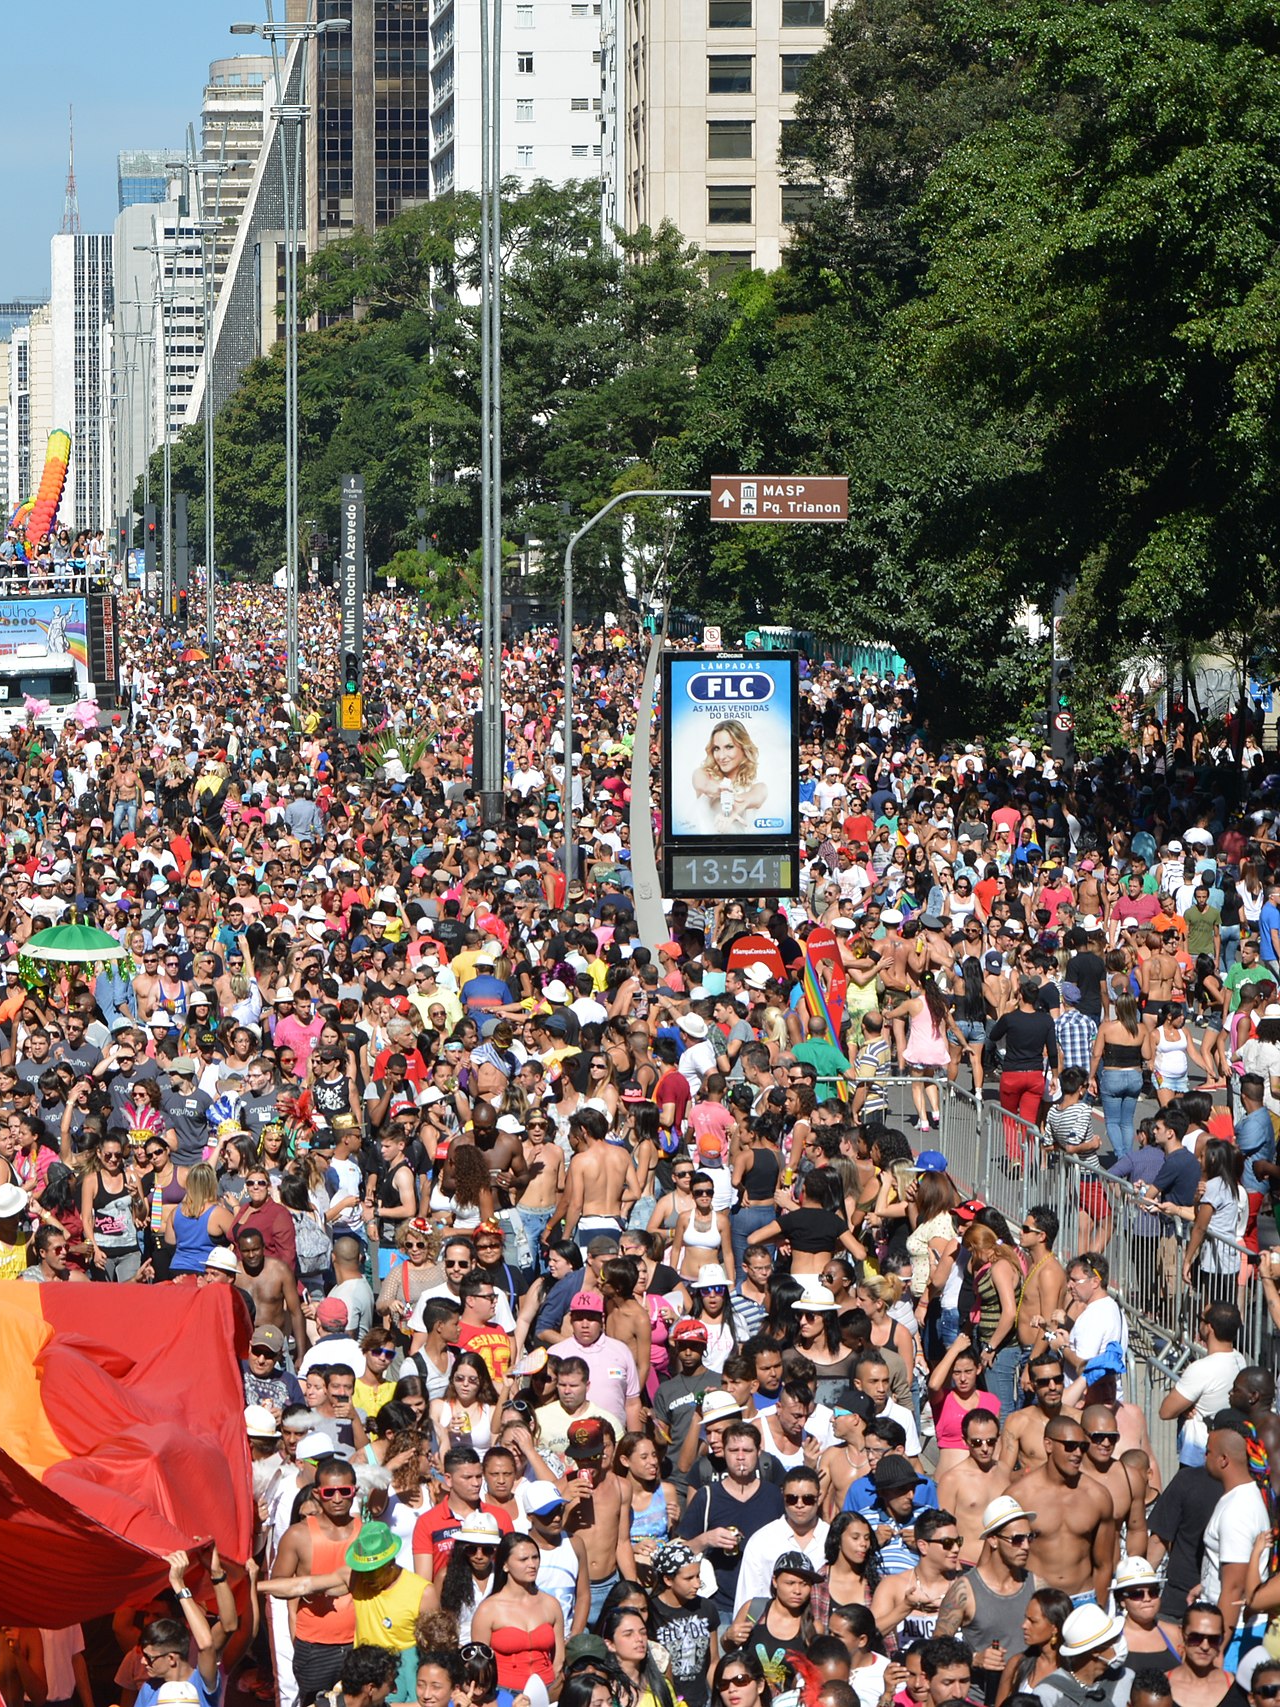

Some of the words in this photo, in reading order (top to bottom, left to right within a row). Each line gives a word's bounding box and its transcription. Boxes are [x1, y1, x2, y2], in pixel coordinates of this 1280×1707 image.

[763, 485, 805, 496] MASP
[763, 502, 783, 514] Pq.
[788, 502, 841, 513] Trianon
[345, 504, 357, 561] Azevedo
[344, 564, 356, 606] Rocha
[344, 636, 355, 653] Al.
[700, 661, 761, 670] LÂMPADAS
[707, 677, 755, 698] FLC
[693, 705, 704, 713] AS
[705, 704, 726, 713] MAIS
[728, 704, 770, 713] VENDIDAS
[709, 712, 722, 720] DO
[724, 711, 753, 720] BRASIL
[685, 858, 767, 885] 13:54
[170, 1108, 194, 1117] orgulho
